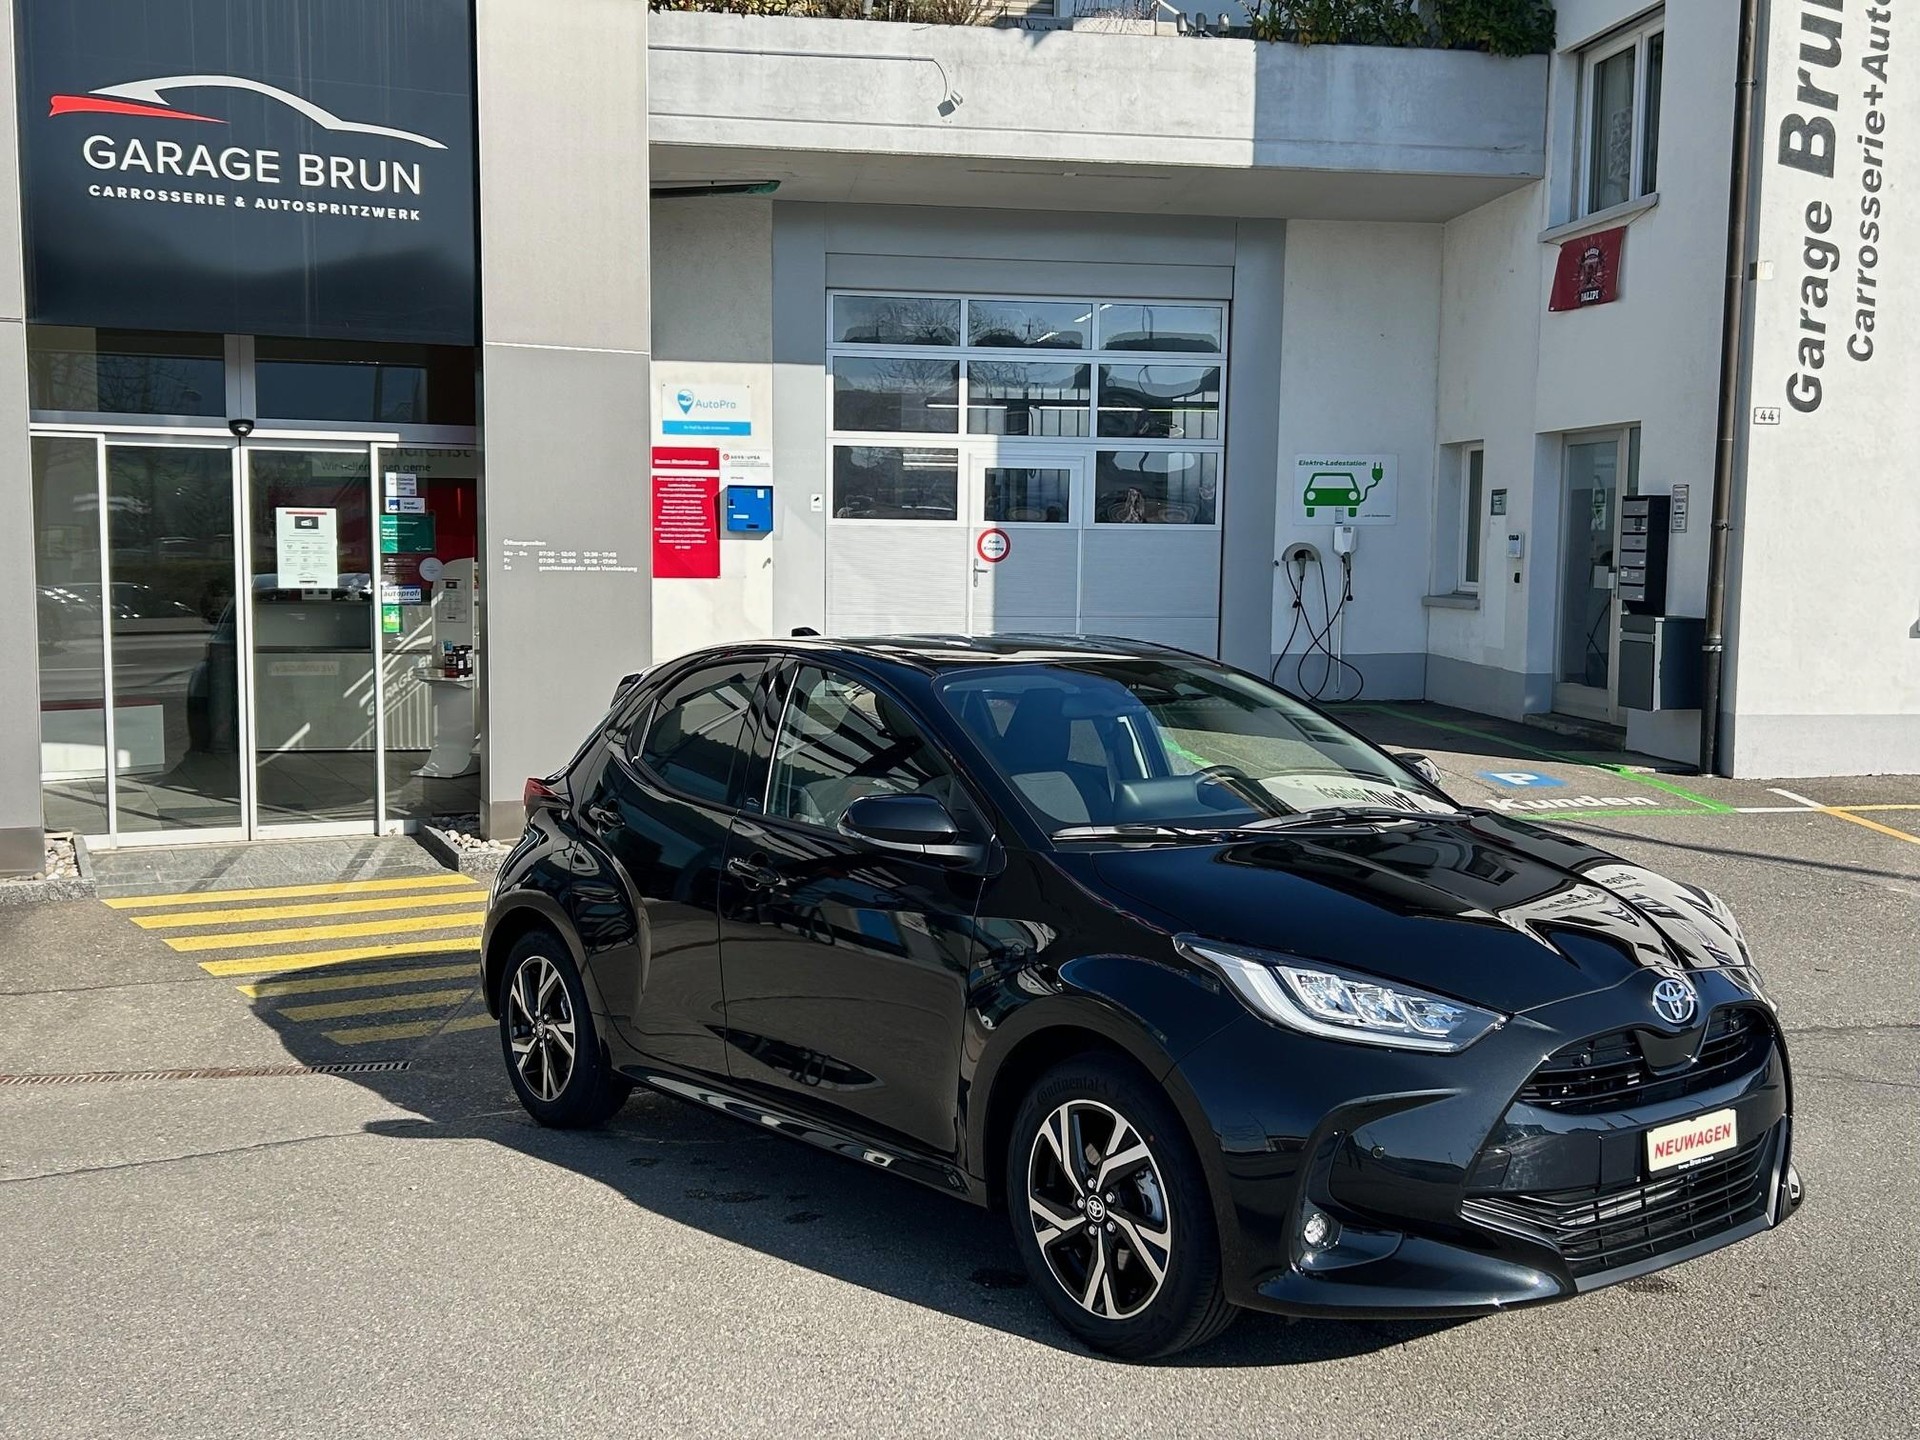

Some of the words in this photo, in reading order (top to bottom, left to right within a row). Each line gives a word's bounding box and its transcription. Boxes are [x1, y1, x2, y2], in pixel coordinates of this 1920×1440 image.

[83, 134, 280, 184] GARAGE
[298, 153, 421, 195] BRUN
[1847, 0, 1891, 362] Carrosserie+Aut
[88, 184, 226, 207] CARROSSERIE
[234, 196, 246, 208] &
[254, 197, 421, 221] AUTOSPRITZWERK
[1787, 201, 1839, 413] Garage
[695, 399, 737, 409] AutoPro
[1760, 410, 1775, 421] 44
[1298, 459, 1367, 467] Elektro-Ladestation
[1486, 795, 1660, 811] Kunden
[1654, 1124, 1731, 1159] NEUWAGEN
